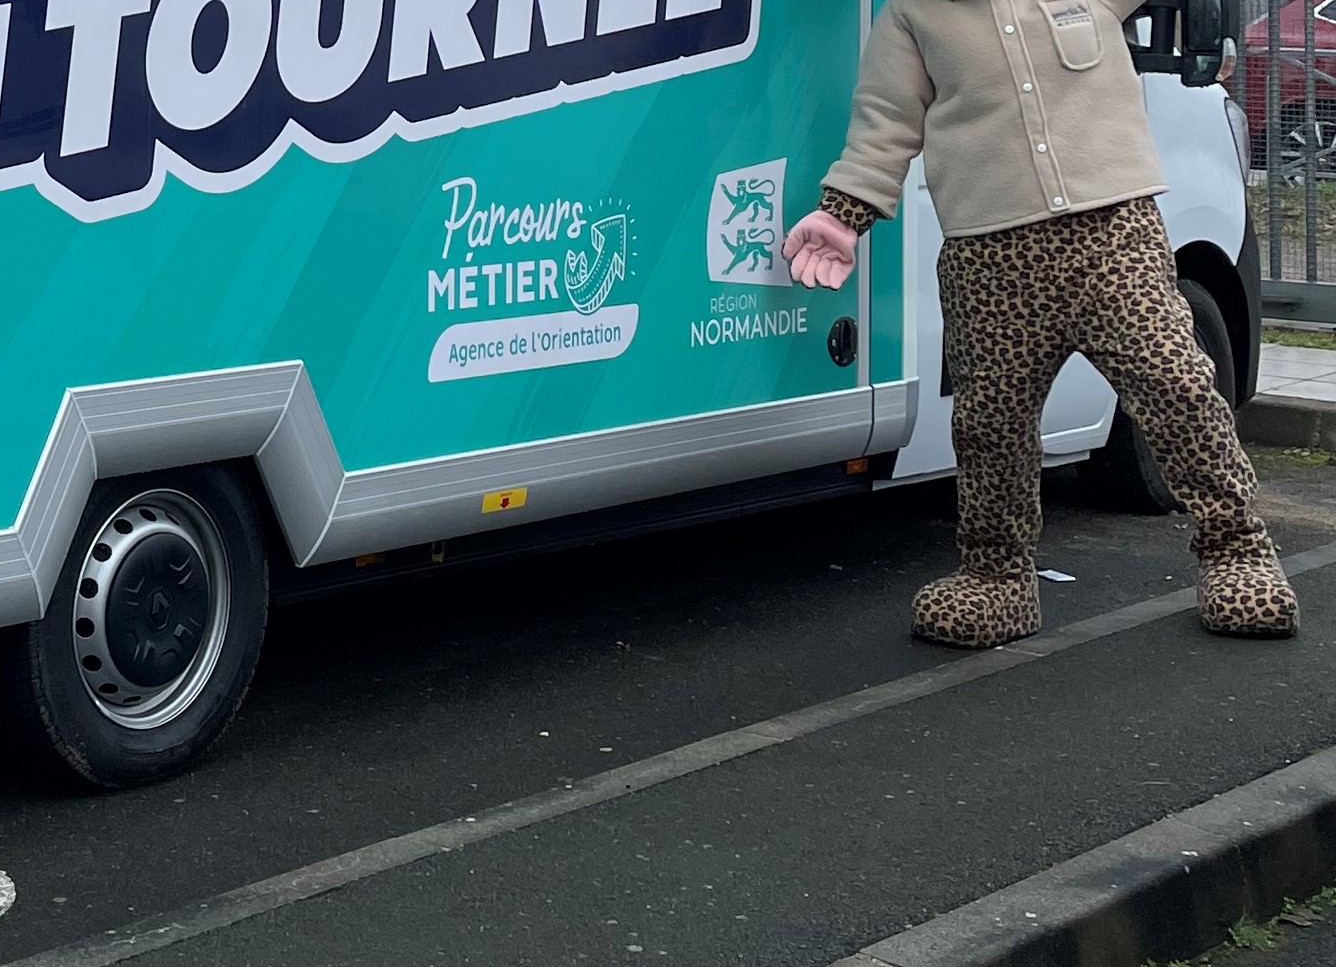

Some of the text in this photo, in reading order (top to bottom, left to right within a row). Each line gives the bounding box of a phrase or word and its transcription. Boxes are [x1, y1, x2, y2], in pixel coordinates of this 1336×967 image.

[441, 176, 586, 260] Parcours
[427, 252, 559, 313] MÉTIER
[710, 293, 758, 314] RÉGION
[449, 323, 621, 368] Agence de l'Orientation
[690, 306, 808, 348] NORMANDIE
